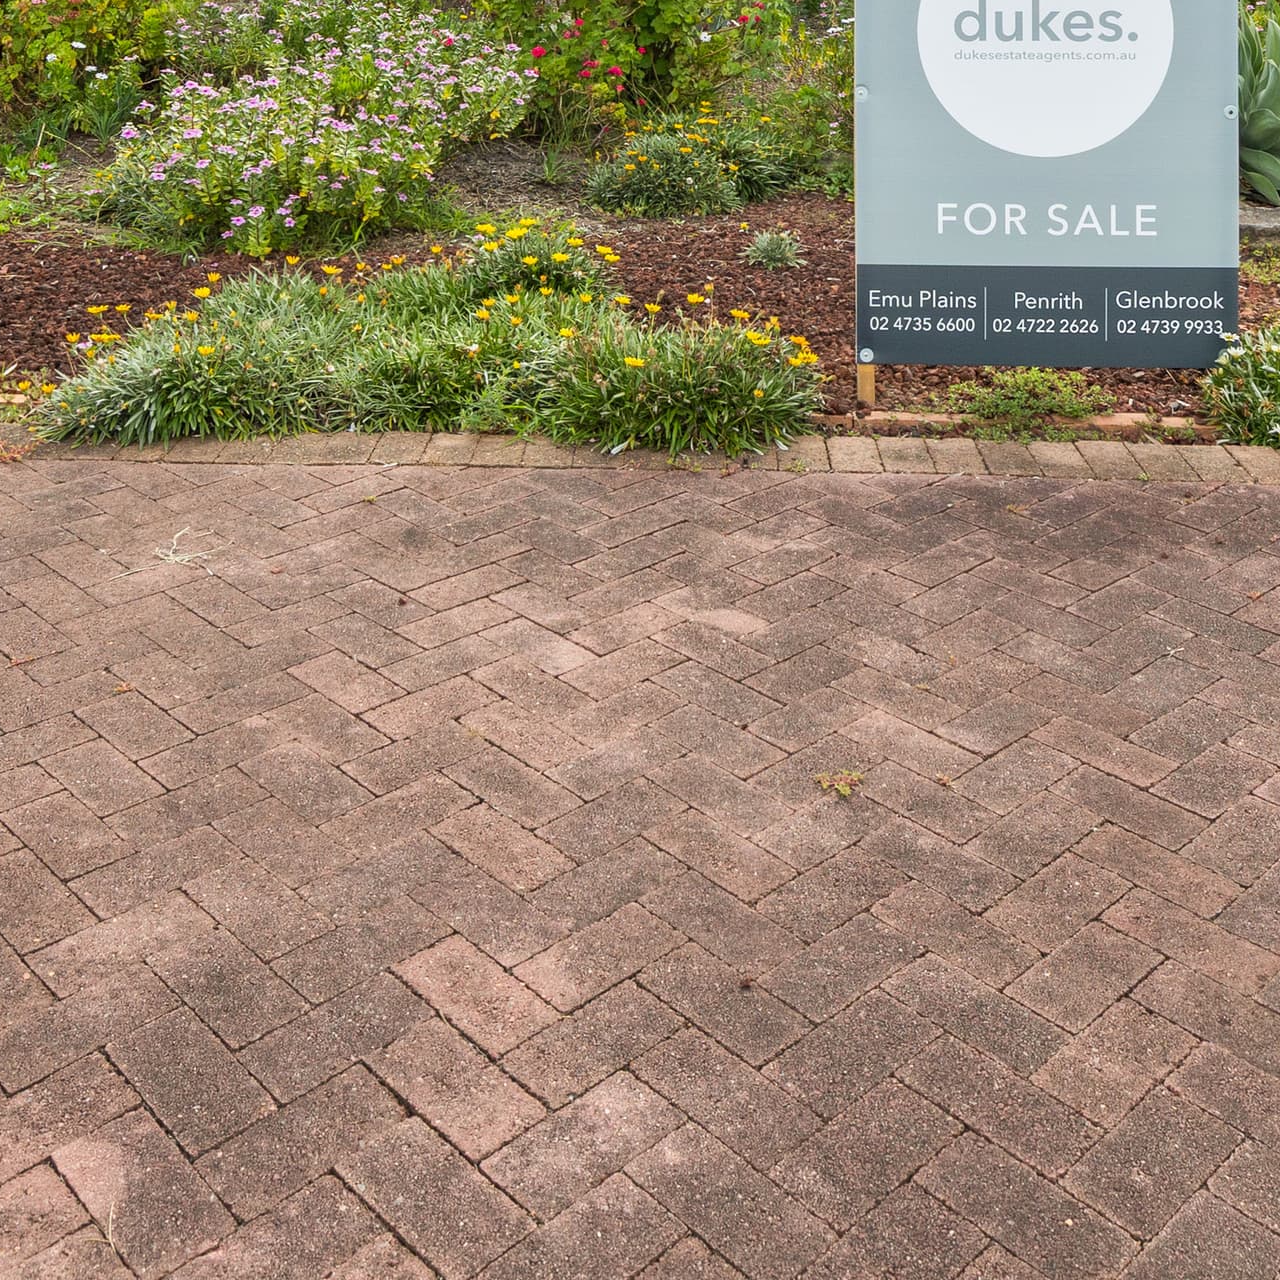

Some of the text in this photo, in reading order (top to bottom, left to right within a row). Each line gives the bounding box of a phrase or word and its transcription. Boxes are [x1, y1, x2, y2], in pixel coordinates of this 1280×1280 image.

[953, 49, 1137, 63] dukesestateagents.com.au
[936, 202, 1158, 237] FOR SALE
[869, 290, 977, 309] Emu Plains
[1014, 291, 1083, 310] Penrith
[1116, 290, 1225, 310] Glenbrook
[870, 316, 976, 332] 02 4735 6600
[992, 318, 1099, 334] 02 4722 2626
[1117, 319, 1223, 335] 02 4739 9933
